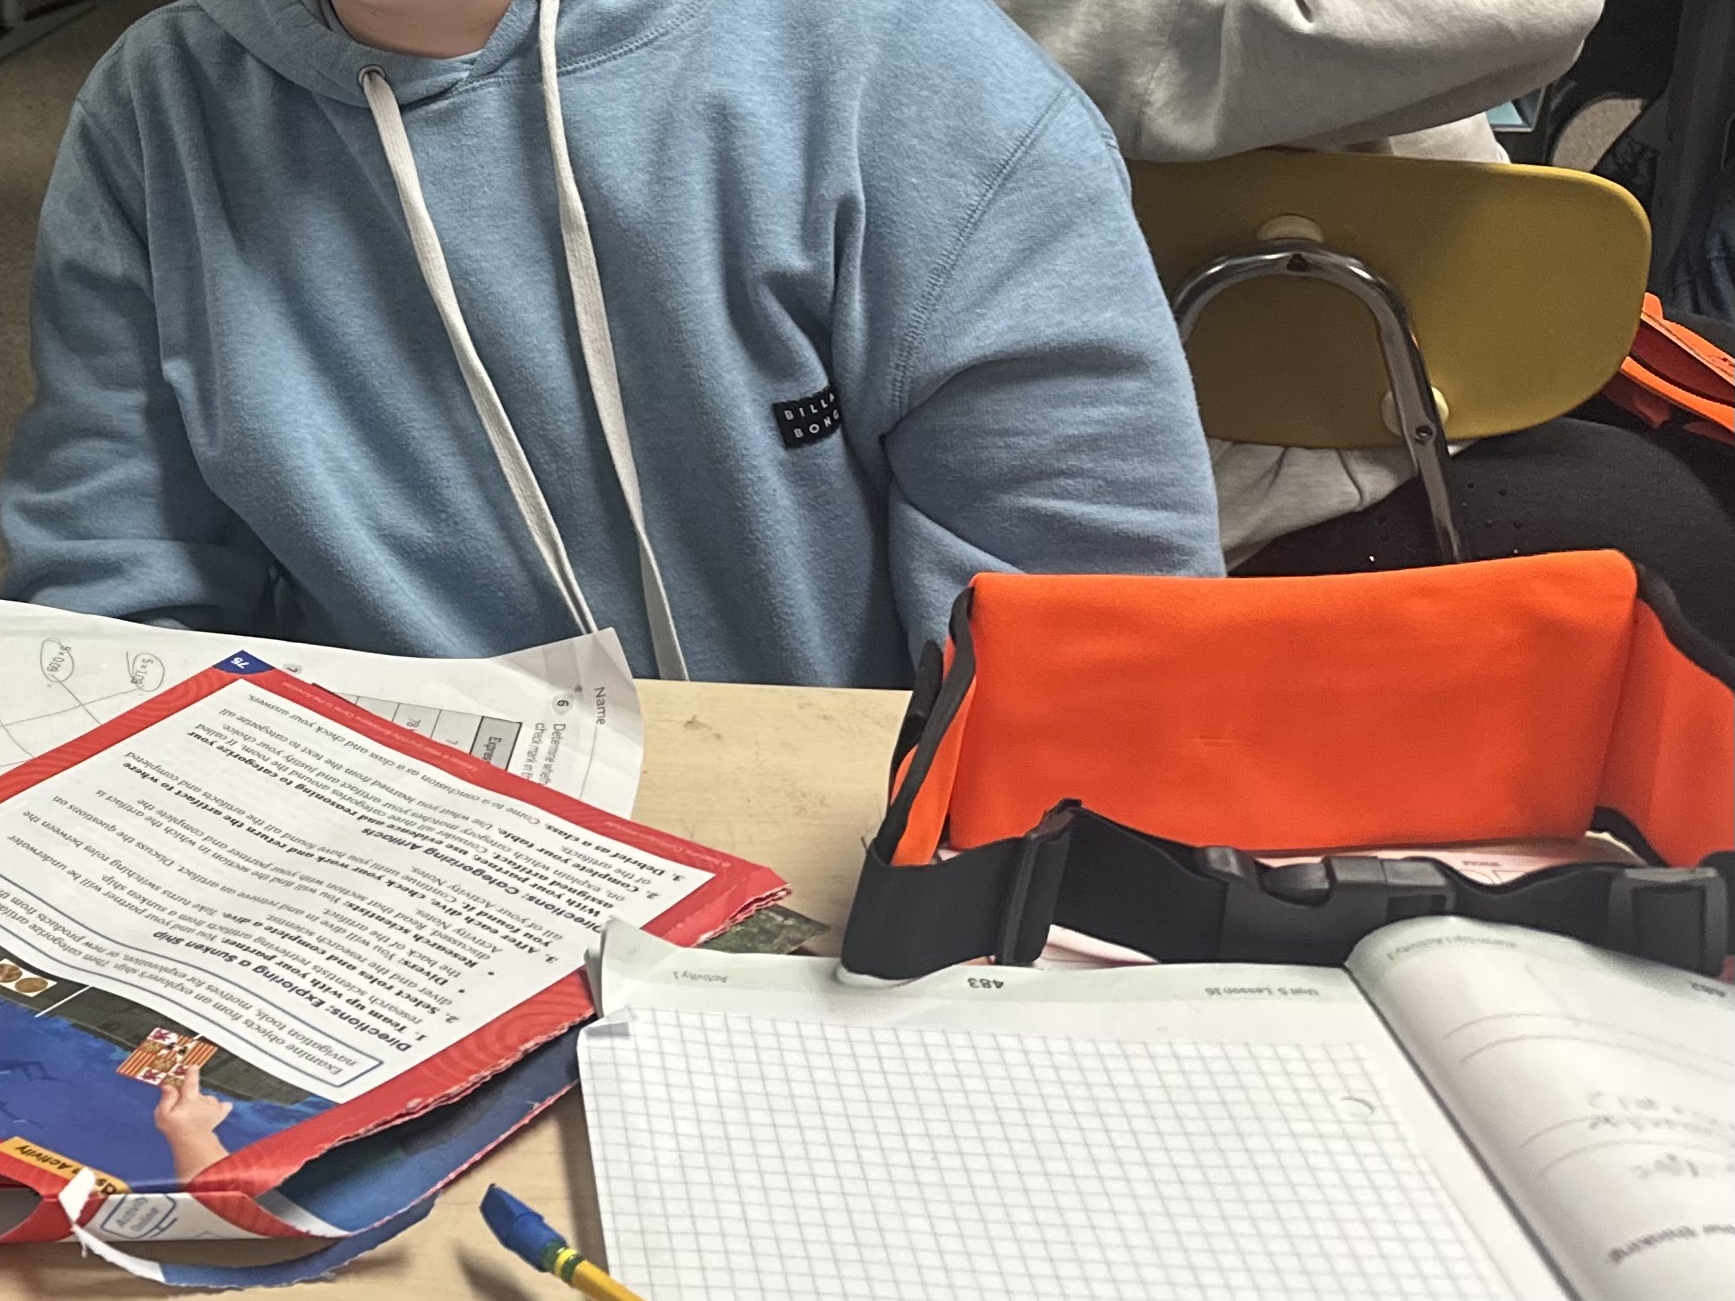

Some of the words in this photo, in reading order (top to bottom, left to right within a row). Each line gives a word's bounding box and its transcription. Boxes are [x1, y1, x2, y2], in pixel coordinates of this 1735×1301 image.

[793, 409, 841, 439] BONG
[591, 685, 612, 727] Name
[123, 763, 158, 783] where
[174, 790, 222, 815] artifact
[246, 827, 287, 848] return
[361, 829, 423, 850] Artifacts
[498, 828, 534, 848] table.
[545, 824, 580, 841] class.
[316, 856, 349, 868] work
[536, 848, 571, 864] your
[609, 853, 665, 876] Debrief
[351, 867, 385, 880] your
[423, 848, 519, 894] Categorizing
[572, 863, 639, 892] Complete
[385, 880, 426, 899] check
[10, 897, 37, 914] from
[431, 899, 462, 916] dive,
[36, 913, 86, 942] products
[223, 912, 251, 924] dive.
[464, 916, 498, 934] each
[28, 924, 82, 956] categorize
[153, 932, 184, 944] Ship
[264, 926, 326, 954] complete
[501, 935, 539, 953] After
[185, 941, 238, 962] Sunken
[221, 938, 277, 961] partner.
[82, 954, 110, 967] Then
[113, 963, 139, 974] ship.
[123, 954, 187, 978] exploration,
[275, 961, 310, 979] your
[138, 971, 193, 994] explorer's
[252, 965, 325, 1007] Exploring
[358, 971, 394, 990] roles
[681, 968, 728, 986] Activity
[966, 974, 1004, 991] 483
[205, 985, 253, 1010] motives
[310, 978, 343, 998] with
[212, 1002, 243, 1021] from
[395, 990, 440, 1014] Select
[255, 1009, 286, 1030] tools,
[325, 1006, 412, 1051] Directions:
[368, 1010, 407, 1033] Team
[242, 1019, 285, 1044] objects
[287, 1029, 357, 1066] navigation
[286, 1044, 343, 1075] Examine
[15, 1142, 68, 1170] Activity
[115, 1195, 150, 1228] Activity
